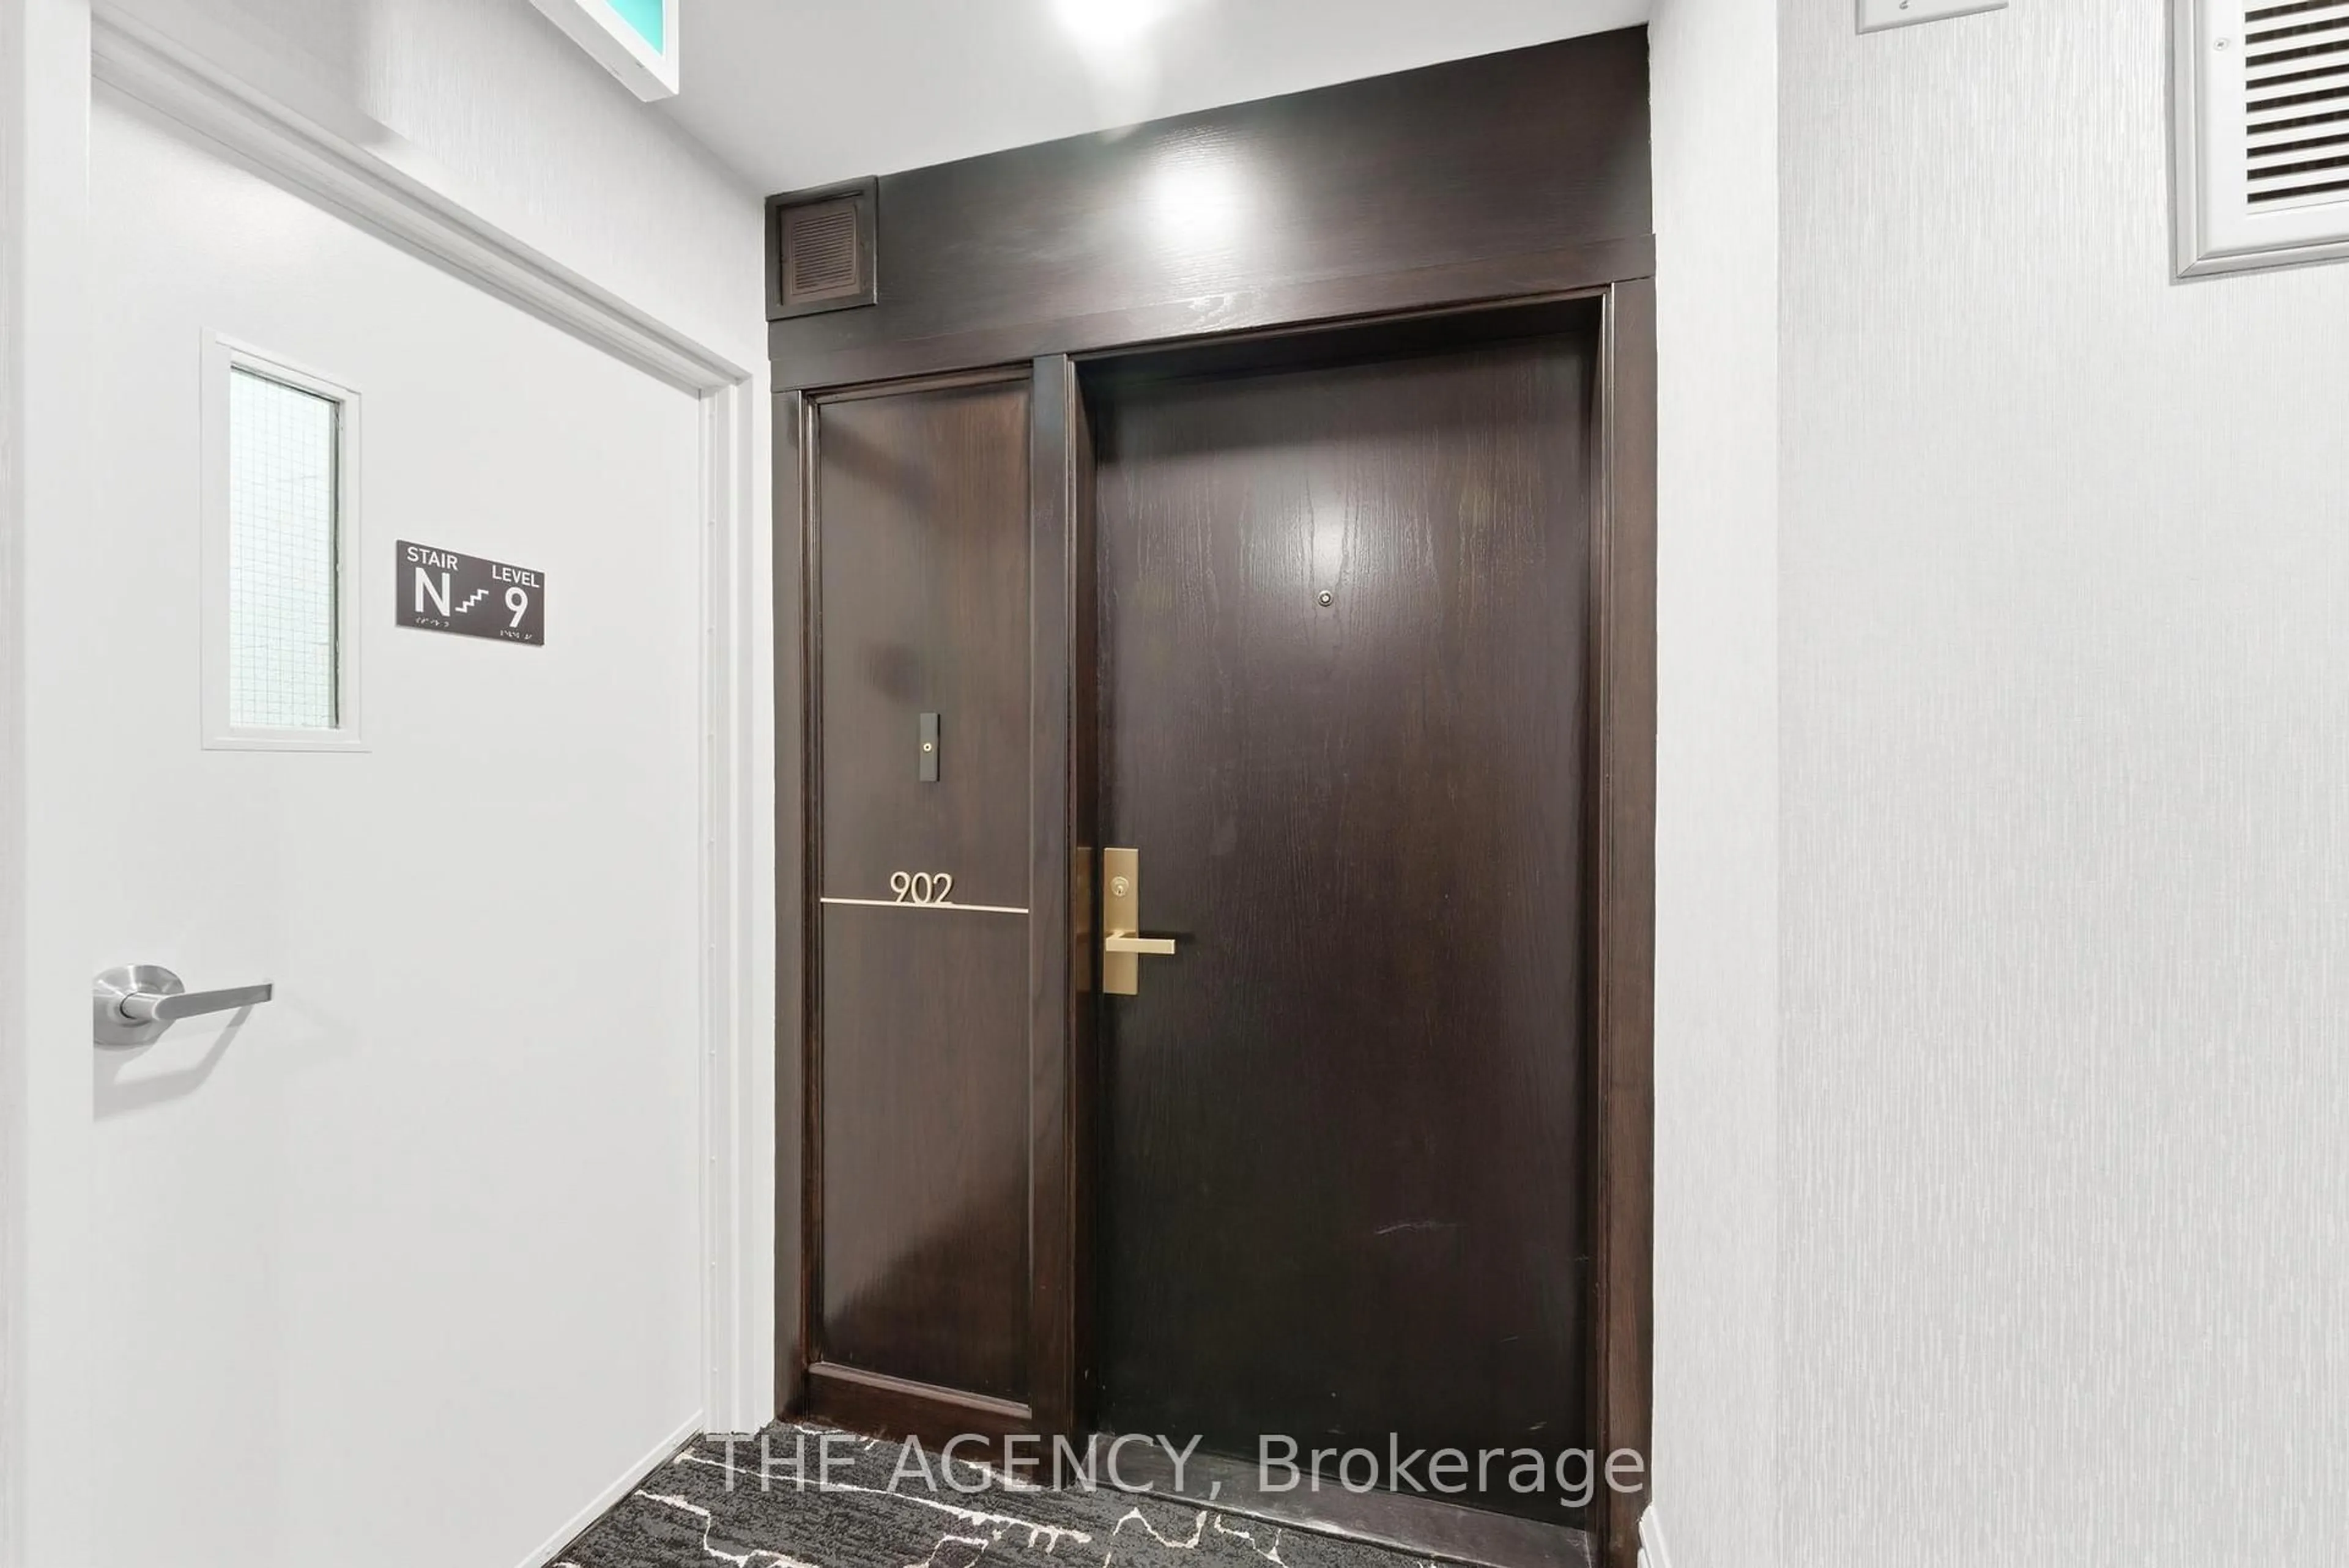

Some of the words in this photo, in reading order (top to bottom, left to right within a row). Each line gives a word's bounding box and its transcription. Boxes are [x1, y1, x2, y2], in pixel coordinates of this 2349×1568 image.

[407, 546, 458, 571] STAIR
[492, 564, 540, 588] LEVEL
[415, 566, 451, 618] N
[505, 586, 529, 628] 9
[890, 871, 952, 906] 902
